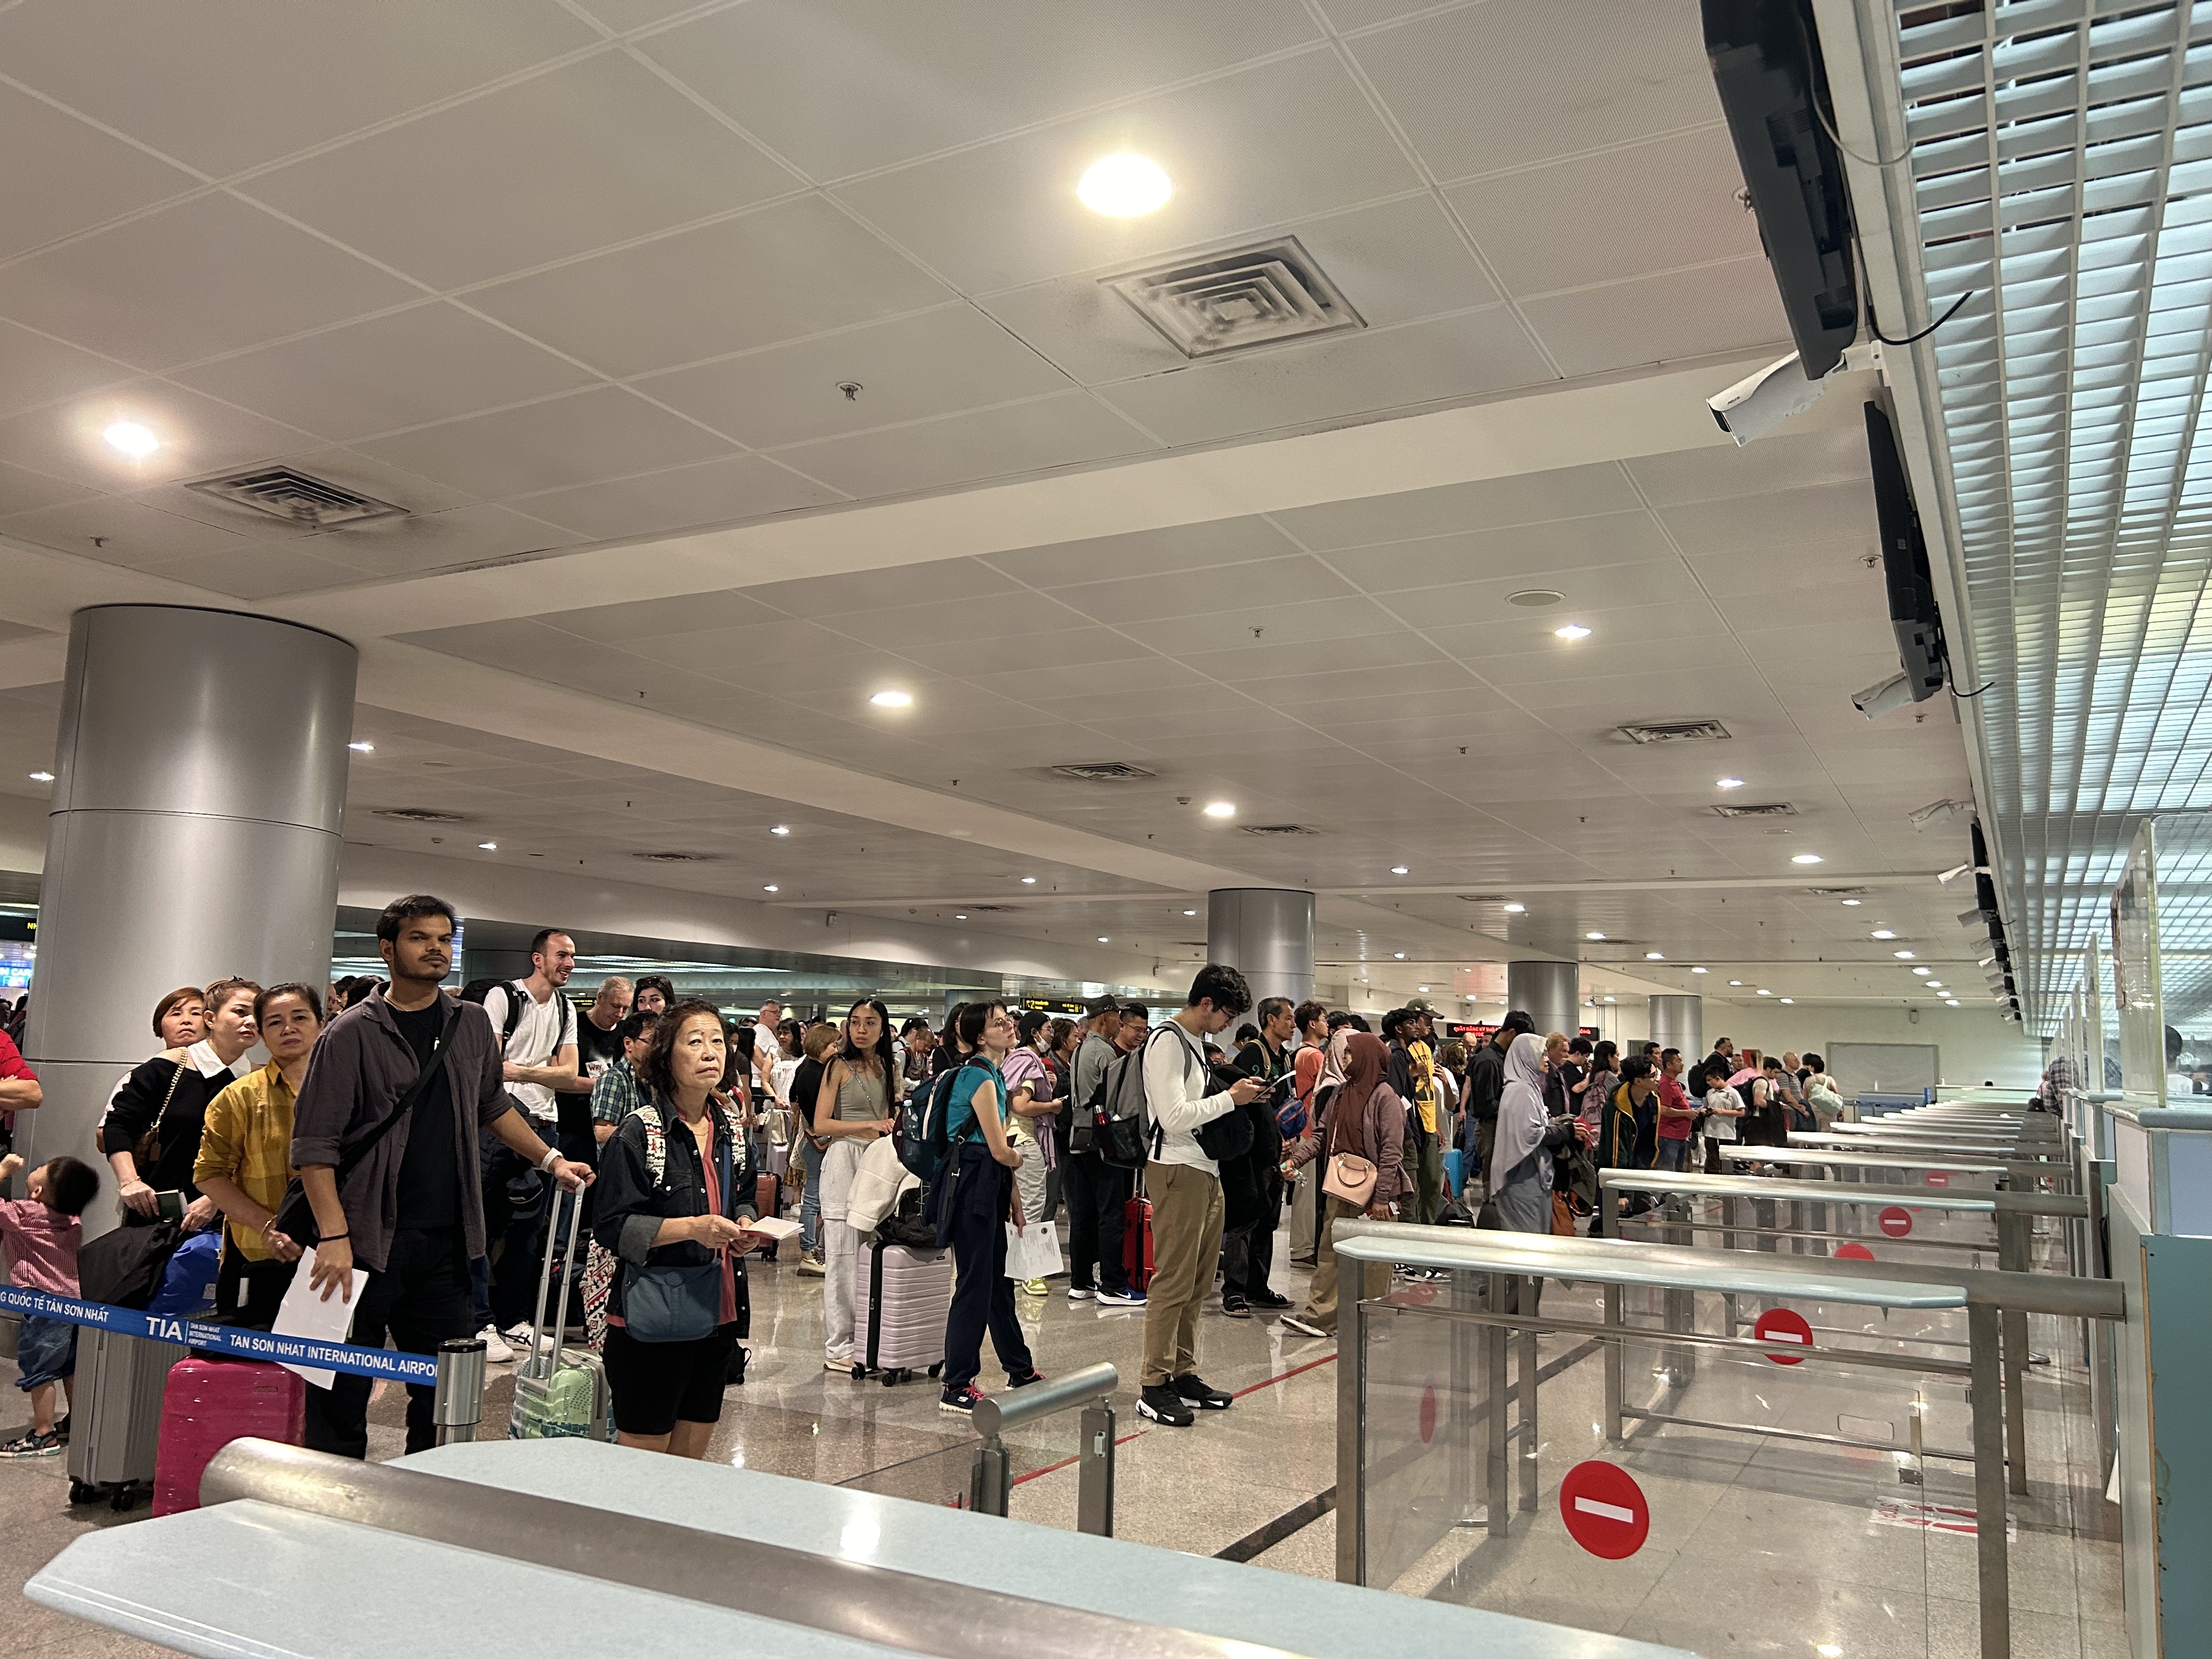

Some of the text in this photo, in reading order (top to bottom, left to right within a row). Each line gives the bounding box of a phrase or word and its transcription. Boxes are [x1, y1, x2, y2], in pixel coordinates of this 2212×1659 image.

[8, 1291, 32, 1307] QUỐC
[34, 1294, 46, 1310] TẾ
[46, 1298, 63, 1313] TÂN
[64, 1304, 83, 1318] SƠN
[84, 1306, 109, 1323] NHẤT
[146, 1316, 183, 1341] TIA
[189, 1330, 222, 1341] INTERNATIONAL
[188, 1338, 208, 1346] AIRPORT
[230, 1334, 250, 1349] TAN
[251, 1338, 274, 1353] SON
[276, 1341, 305, 1358] NHAT
[307, 1346, 396, 1372] INTERNATIONAL
